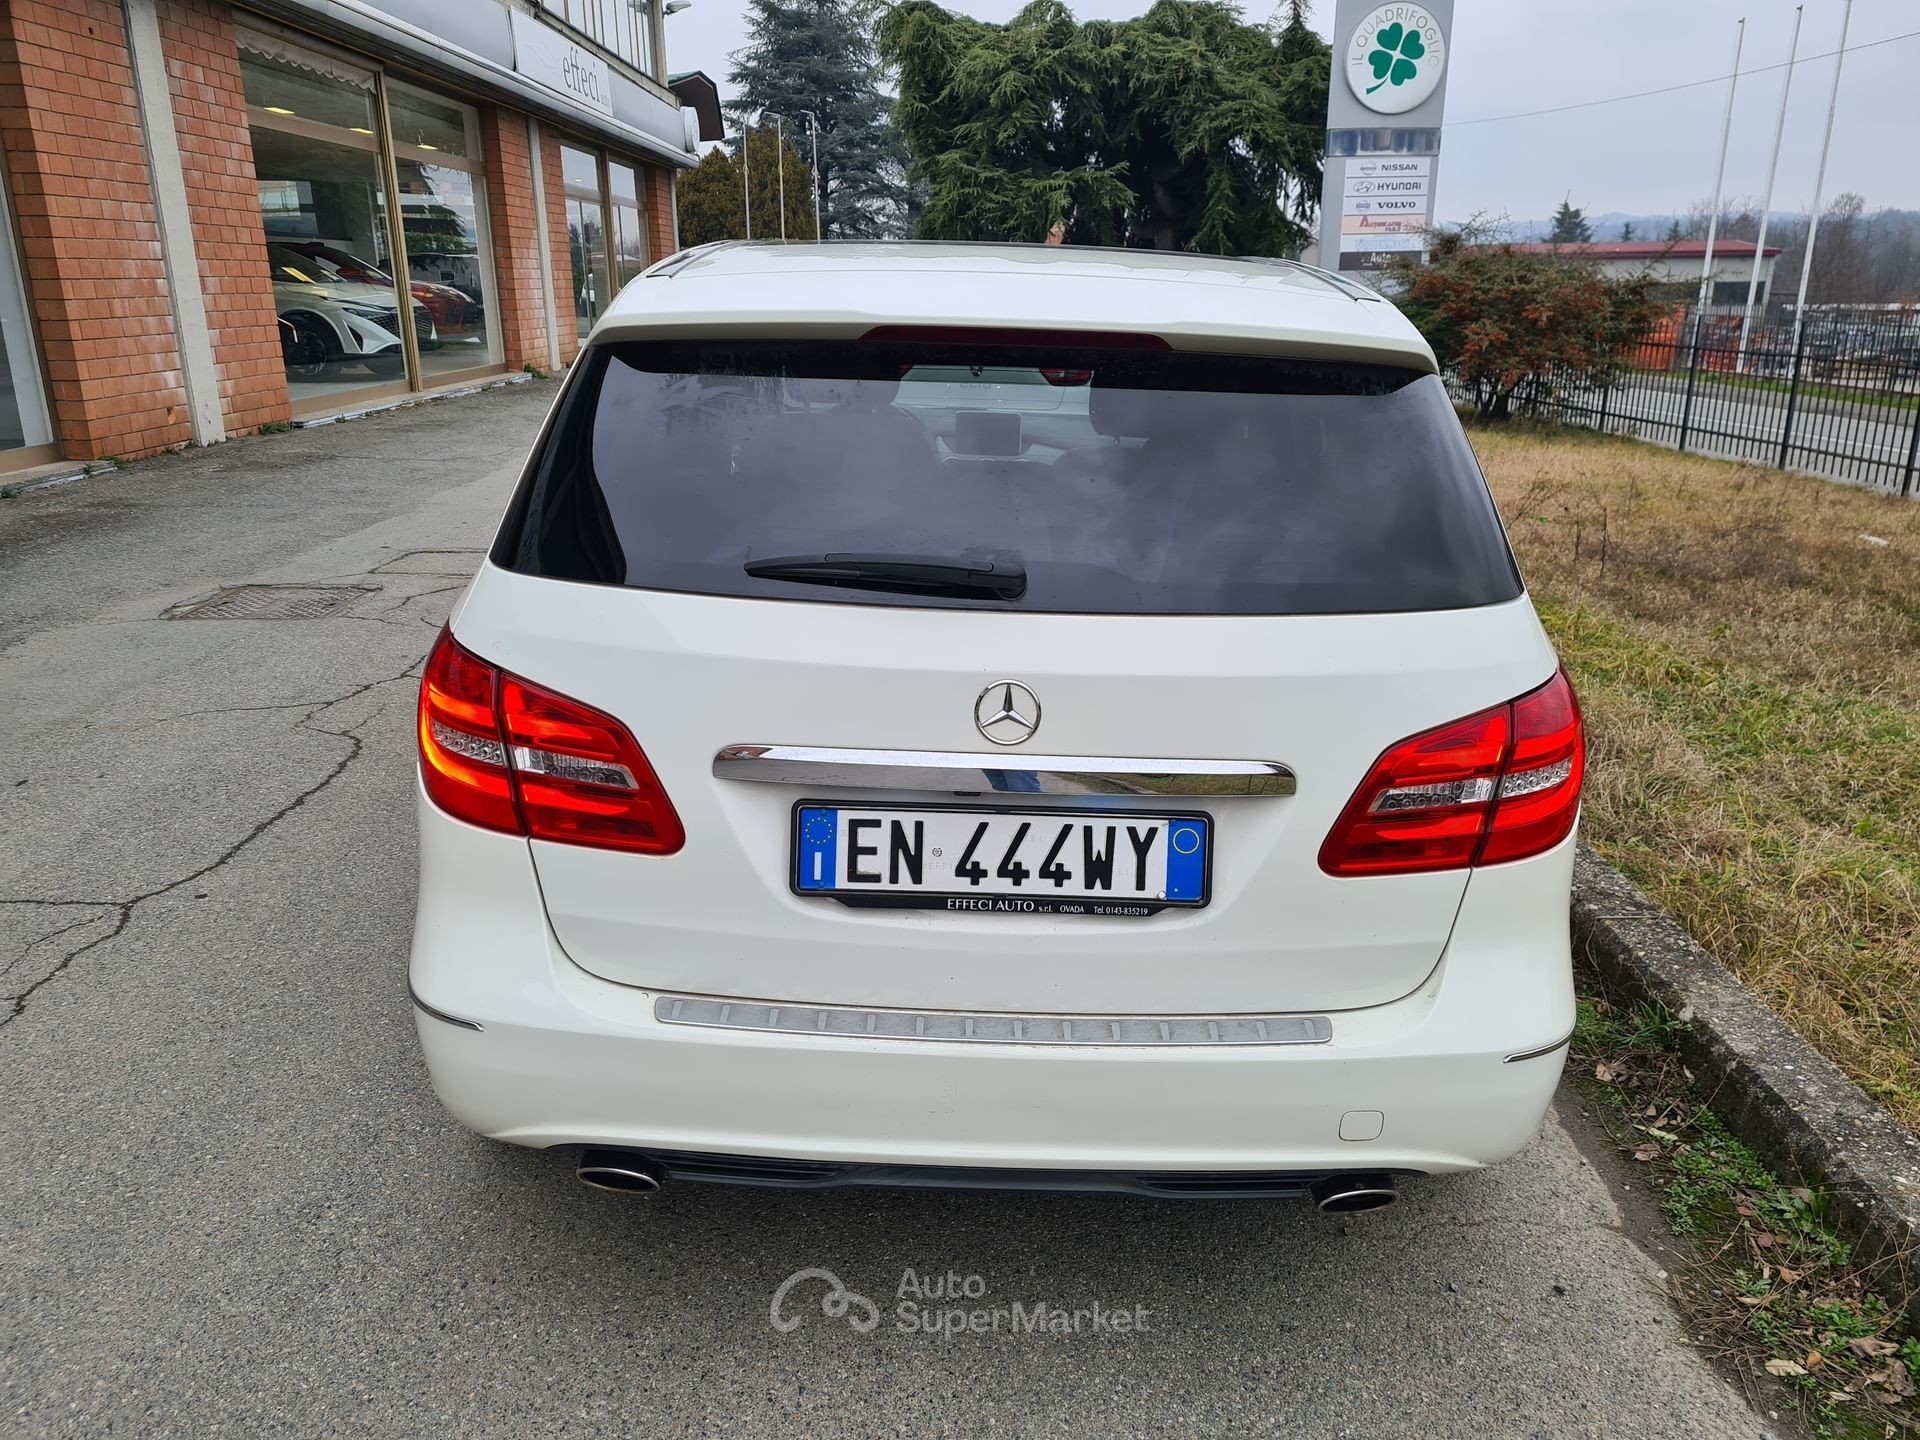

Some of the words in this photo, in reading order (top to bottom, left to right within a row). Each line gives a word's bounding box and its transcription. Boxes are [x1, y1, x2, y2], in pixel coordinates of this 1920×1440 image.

[1355, 7, 1441, 68] QUADRIFOGLIO
[1351, 53, 1364, 66] IL
[562, 46, 600, 103] effeci
[1381, 163, 1418, 171] NISSAN
[1377, 181, 1422, 191] HYUNDAI
[1377, 201, 1416, 209] VOLVO
[847, 818, 924, 885] EN
[954, 821, 1159, 891] 444WY
[947, 898, 992, 910] EFFECI
[995, 900, 1034, 912] AUTO
[1060, 905, 1085, 913] OVADA
[1105, 906, 1148, 916] 0143-835219
